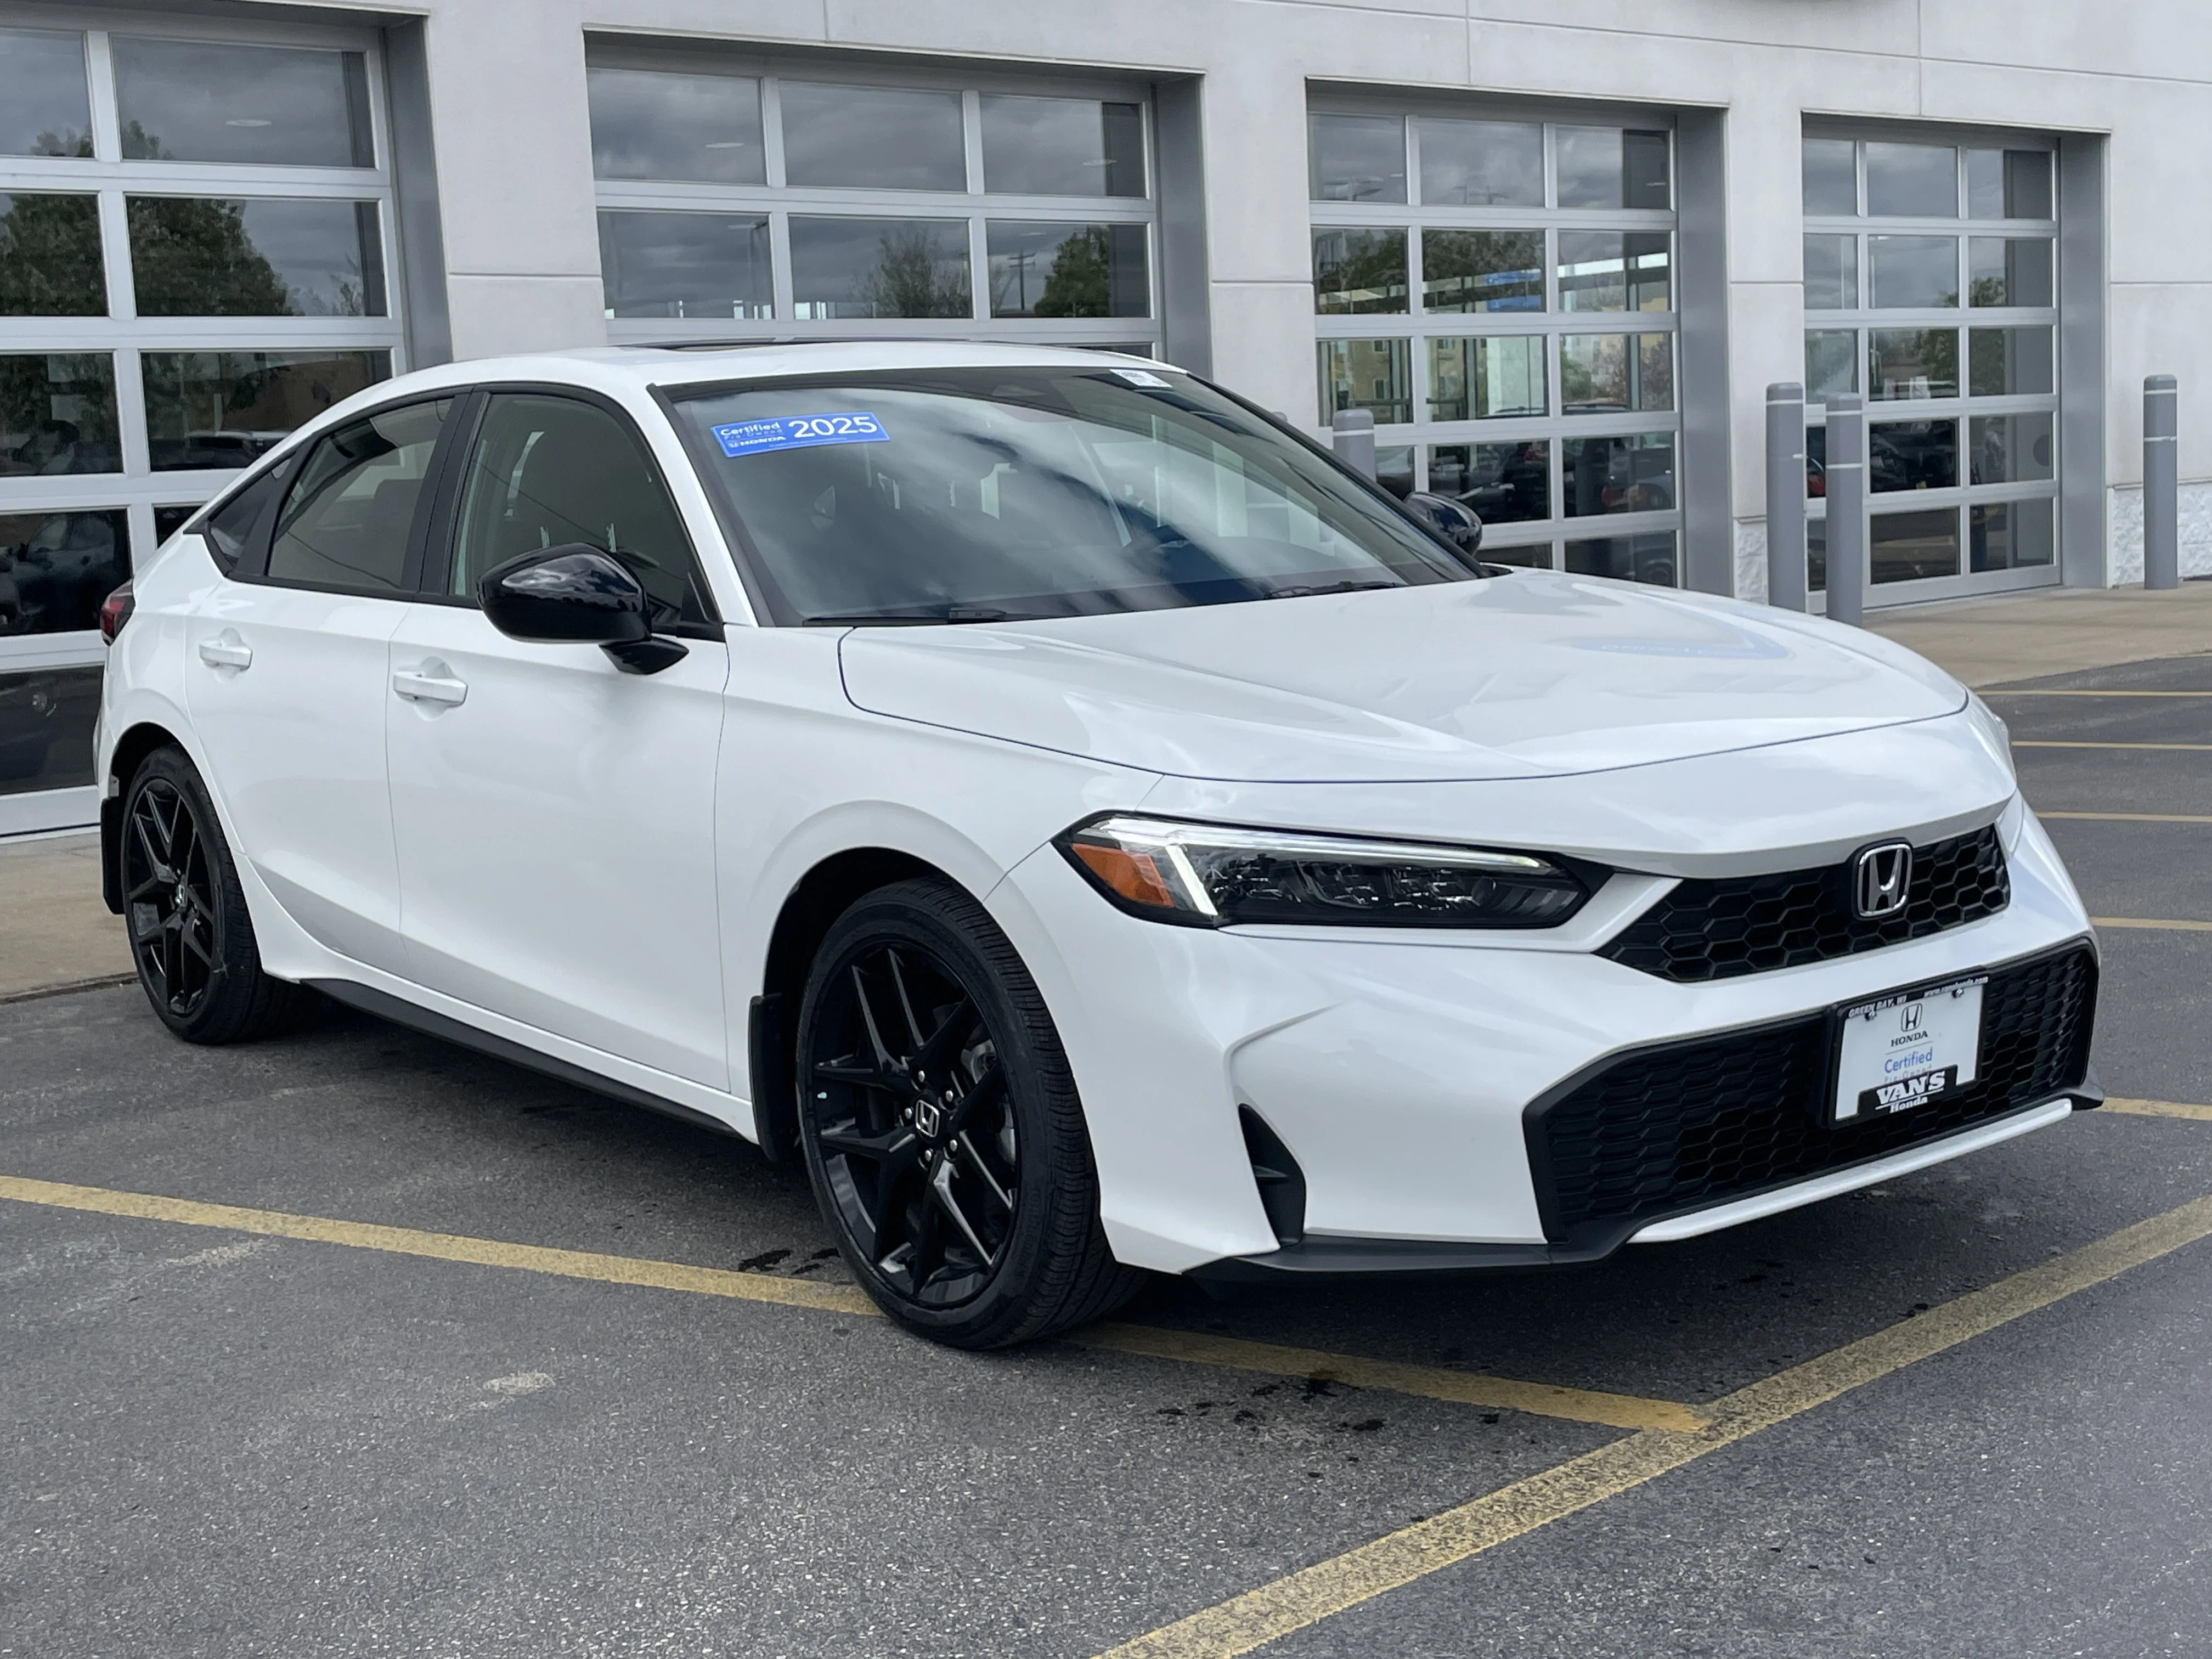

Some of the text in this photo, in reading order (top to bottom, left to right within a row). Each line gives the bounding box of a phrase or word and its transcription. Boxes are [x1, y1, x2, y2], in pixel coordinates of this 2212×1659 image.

[720, 421, 781, 436] Certified
[788, 416, 878, 438] 2025
[1848, 1002, 1876, 1019] GREEN
[1890, 1030, 1928, 1047] HONDA
[1884, 1047, 1933, 1074] Certified
[1876, 1070, 1945, 1105] VANS
[1889, 1097, 1928, 1114] Honda
